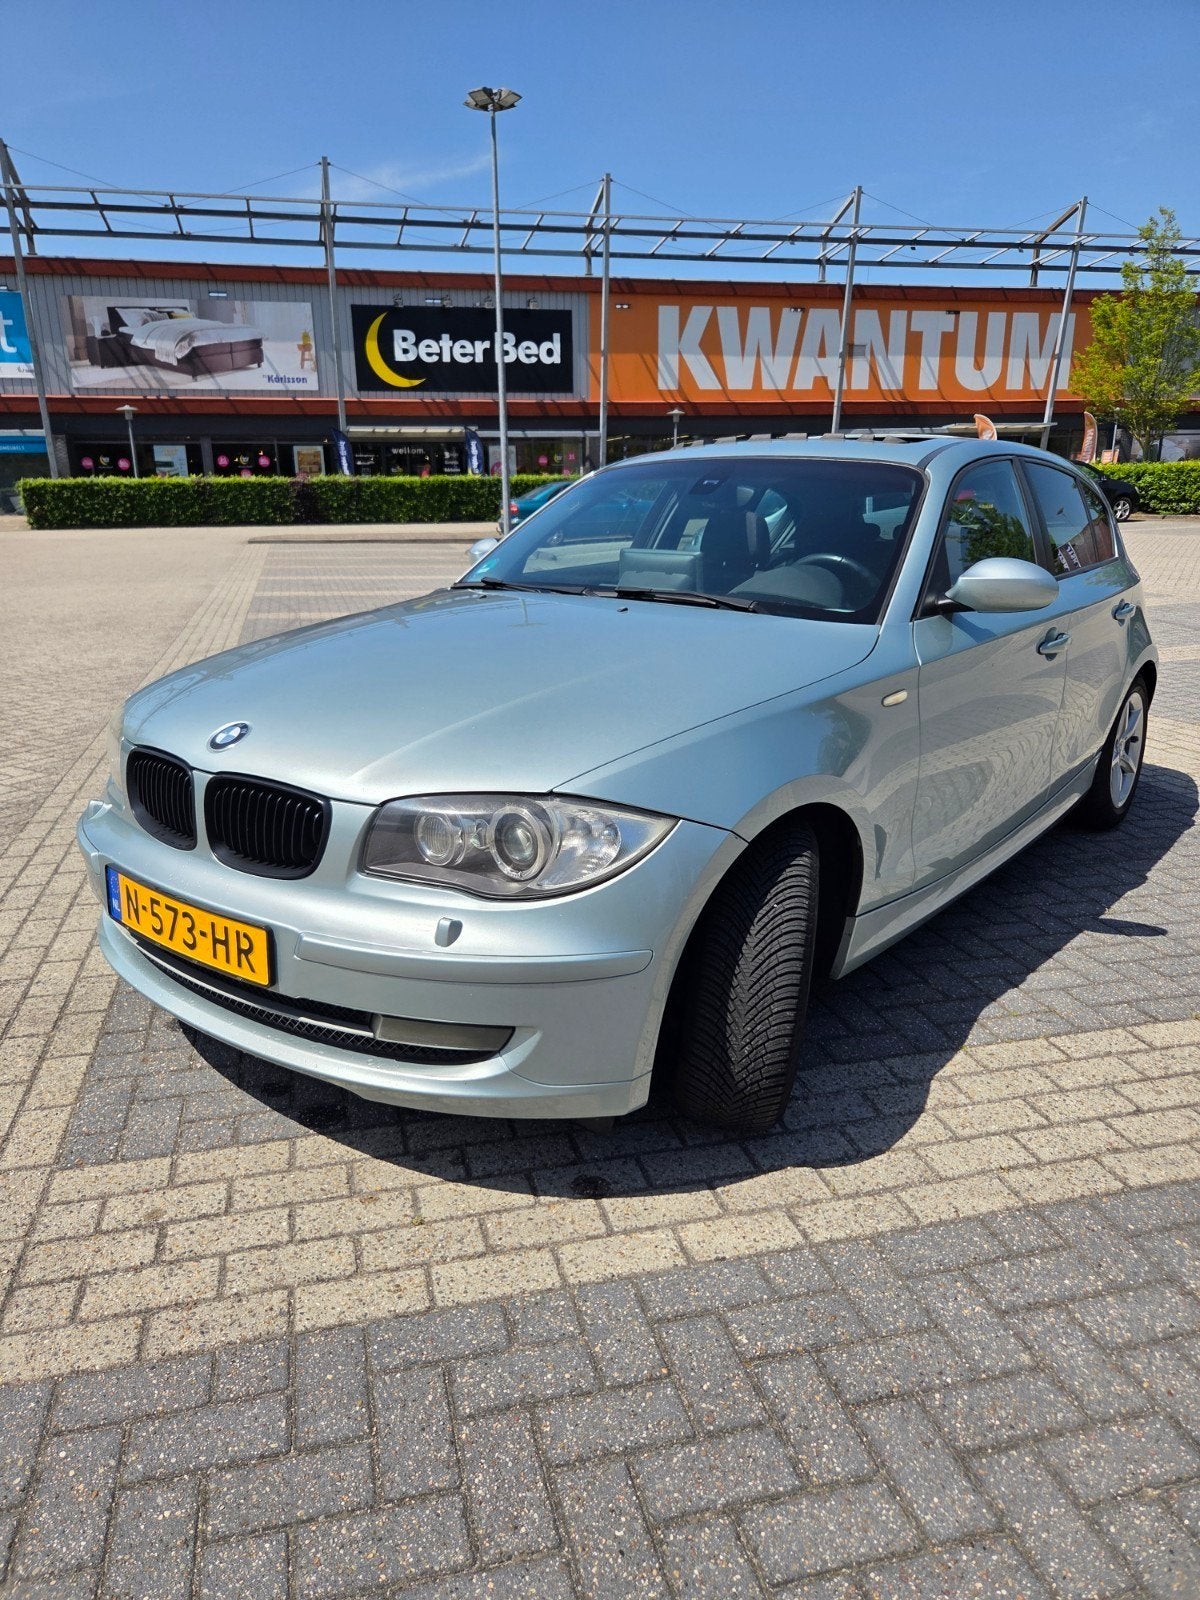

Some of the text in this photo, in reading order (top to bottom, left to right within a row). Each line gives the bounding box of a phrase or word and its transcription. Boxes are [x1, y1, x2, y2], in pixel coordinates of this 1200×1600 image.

[393, 329, 561, 365] Beter Bed
[657, 305, 1077, 390] KWANTUM
[125, 884, 256, 974] N-573-HR
